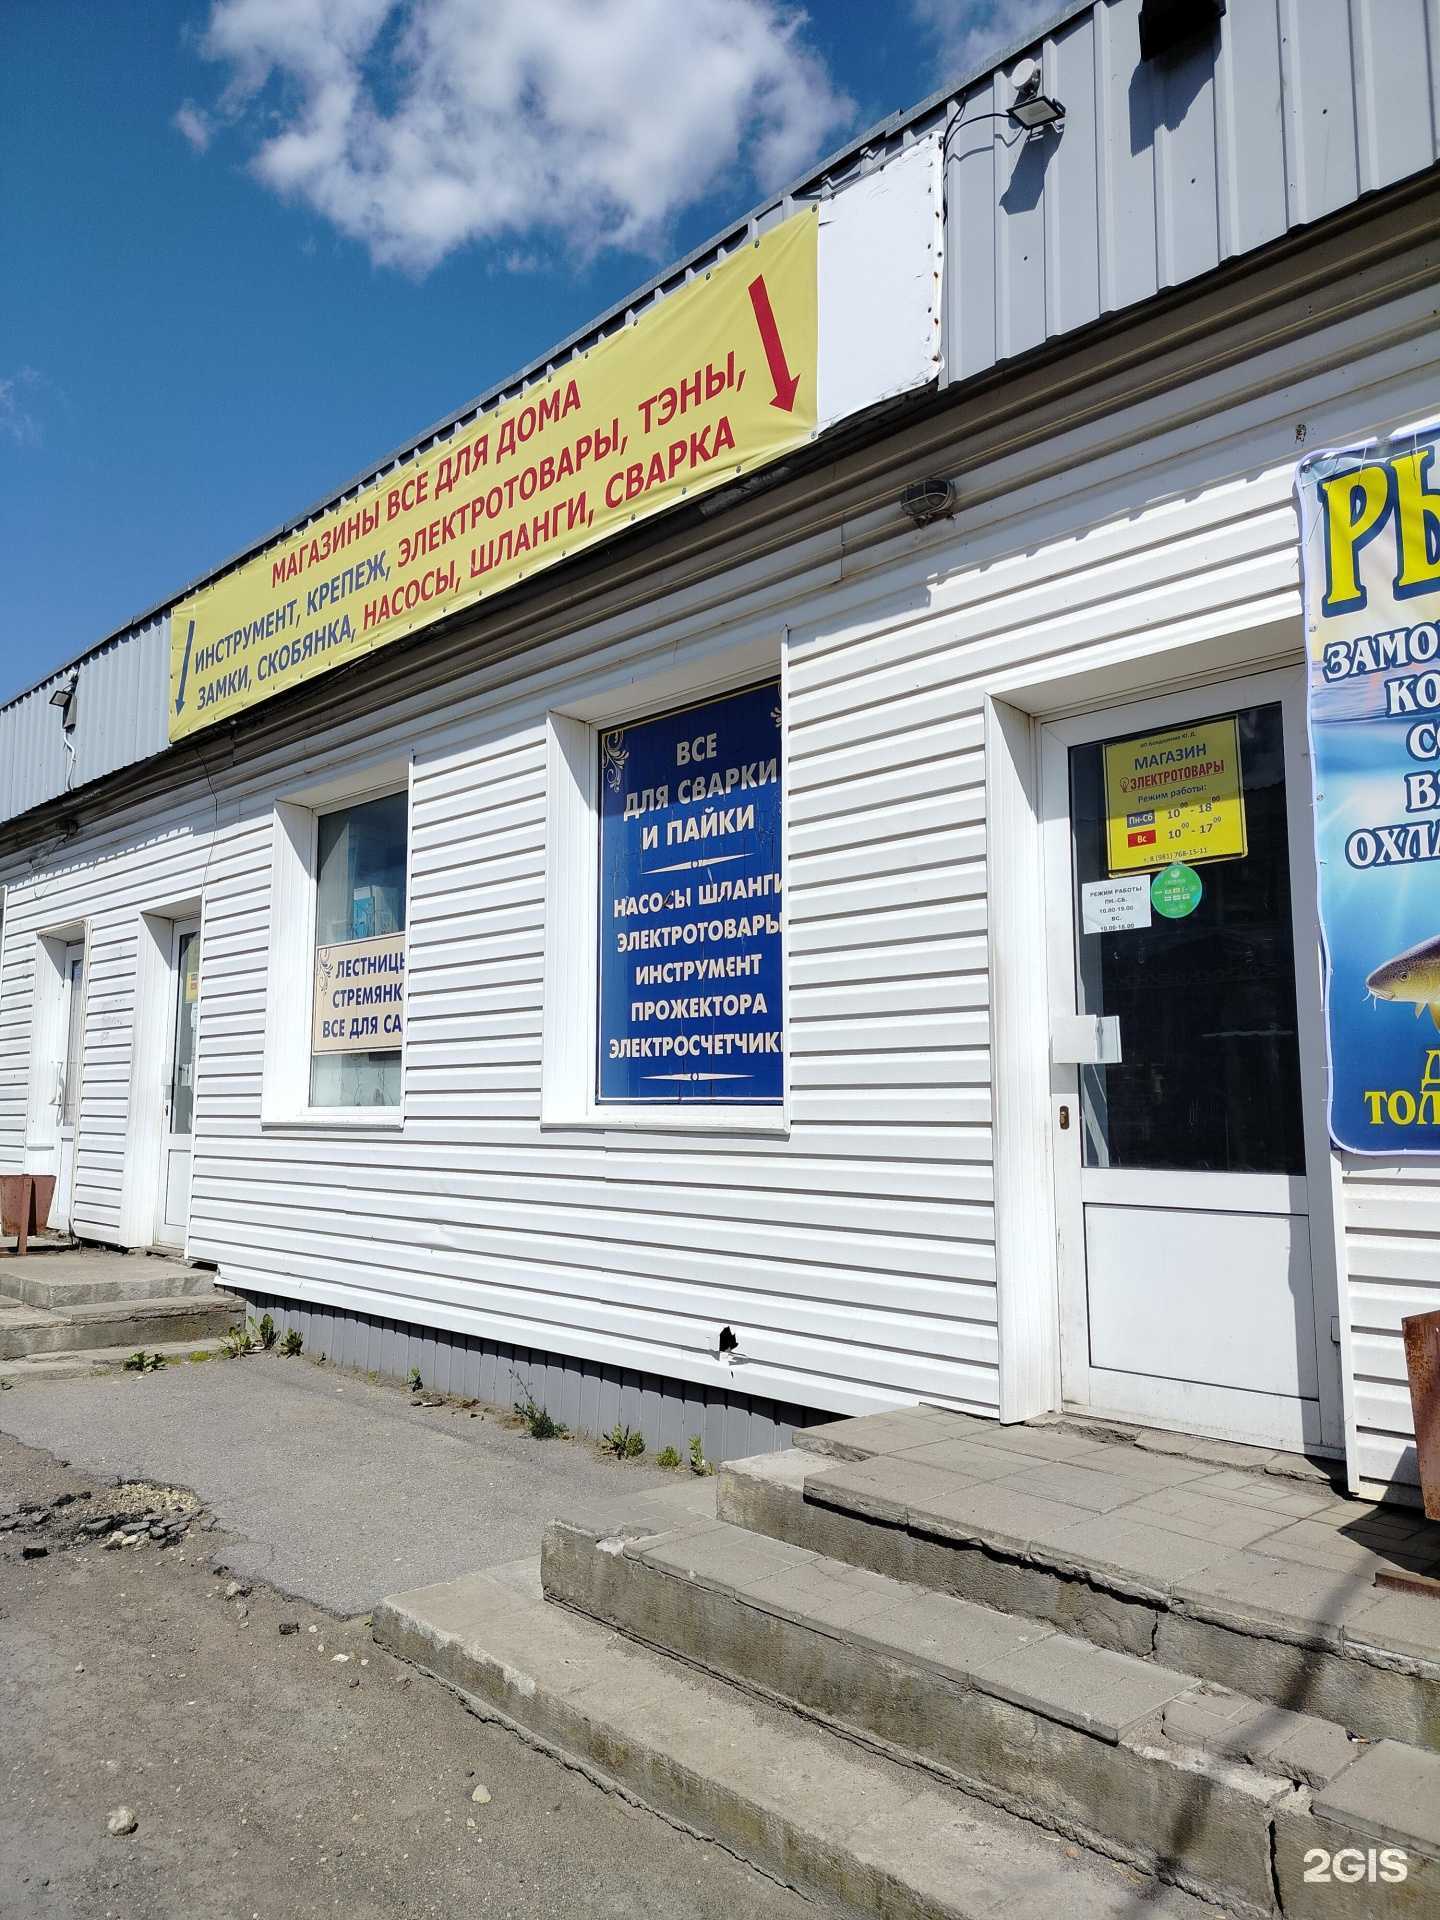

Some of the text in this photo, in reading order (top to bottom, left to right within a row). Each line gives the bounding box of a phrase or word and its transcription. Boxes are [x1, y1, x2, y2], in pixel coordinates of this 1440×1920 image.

[271, 379, 581, 588] МАГАЗИНЫ ВСЕ ДЛЯ ДОМА
[195, 350, 746, 674] ИНСТРУМЕНТ, КРЕПЕЖ, ЭЛЕКТРОТОВАРЫ, ТЭНЫ,
[197, 415, 736, 711] ЗАМКИ, СКОБЯНКА, НАСОСЫ, ШЛАНГИ, СВАРКА
[676, 732, 718, 767] ВСЕ
[1134, 743, 1207, 771] МАГАЗИН
[623, 757, 777, 822] ДЛЯ СВАРКИ
[1130, 760, 1224, 790] ЭЛЕКТРОТОВАРЫ
[1137, 784, 1207, 804] Режим работы:
[642, 804, 754, 850] И ПАЙКИ
[1128, 812, 1153, 825] Пн-Сб
[1137, 835, 1147, 843] Вс
[1090, 886, 1142, 897] РЕЖИМ РАБОТЫ
[635, 954, 762, 985] ИНСТРУМЕНТ
[631, 993, 767, 1021] ПРОЖЕКТОРА
[322, 1019, 345, 1038] ВСЕ
[349, 1016, 378, 1039] ДЛЯ
